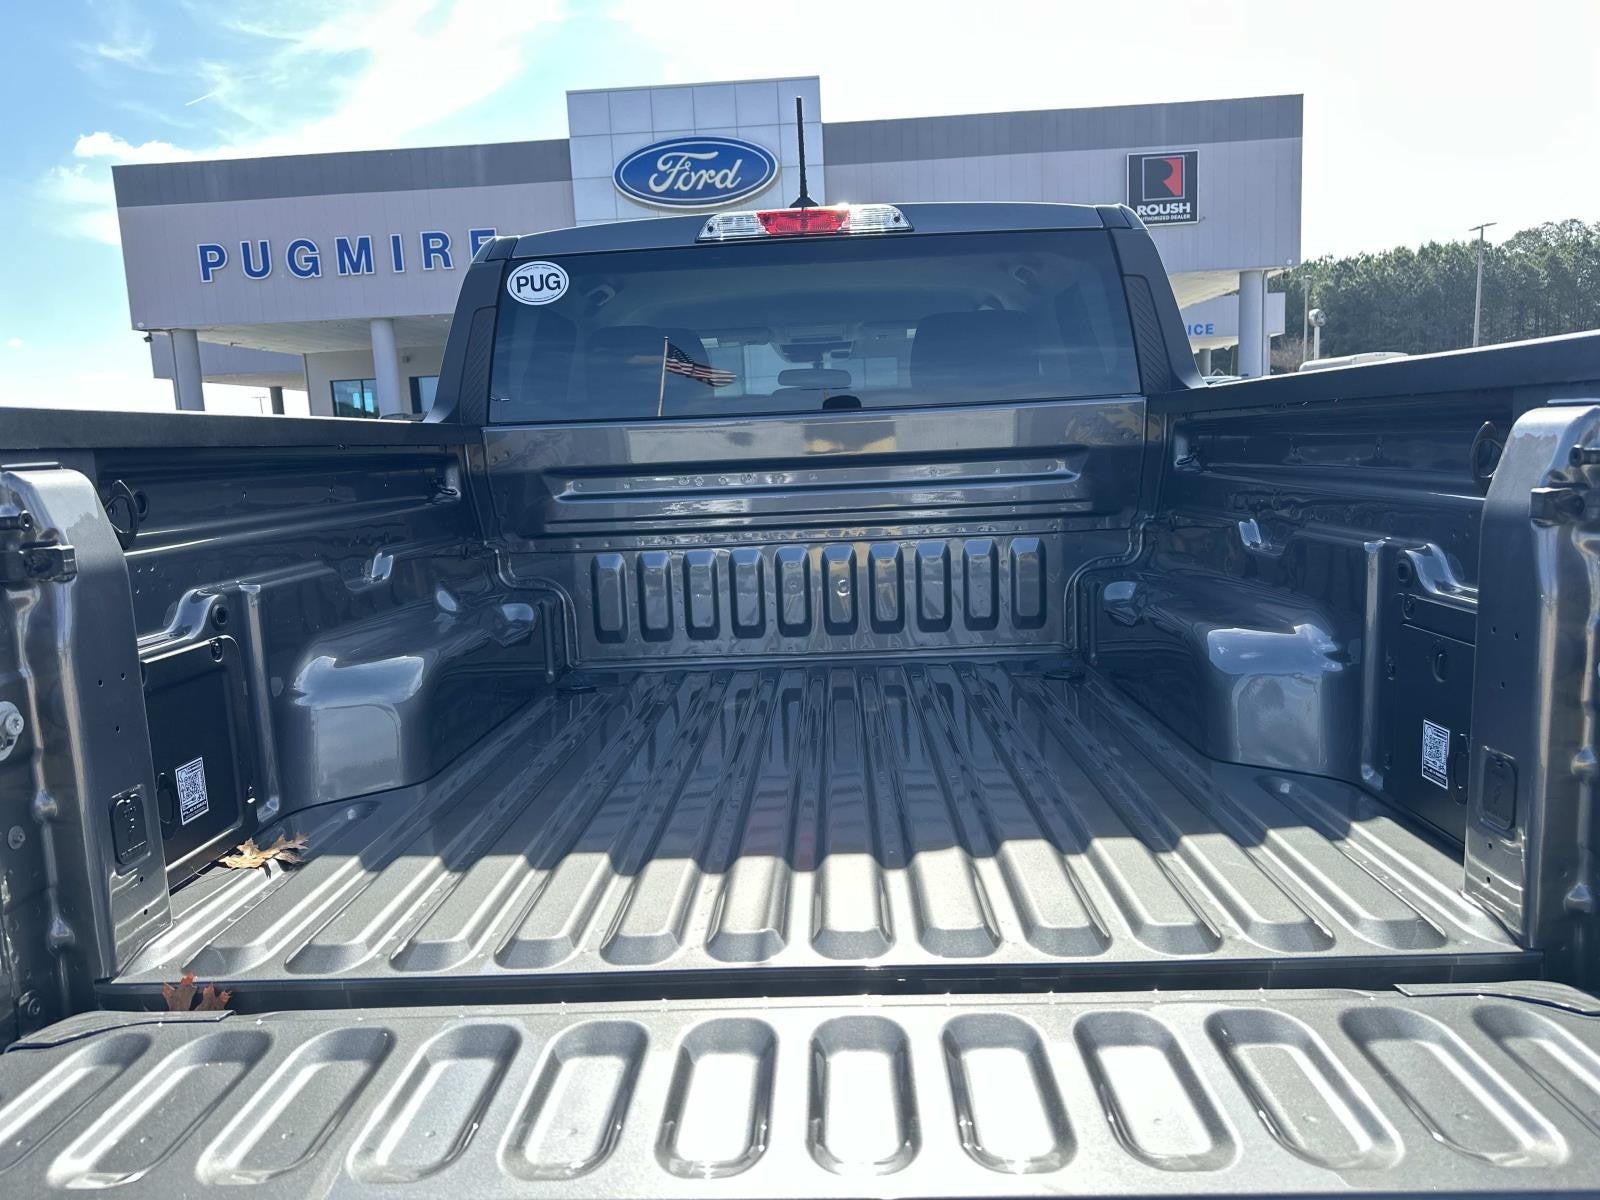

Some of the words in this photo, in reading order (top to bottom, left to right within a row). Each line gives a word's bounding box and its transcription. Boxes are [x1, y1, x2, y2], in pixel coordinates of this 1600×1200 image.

[649, 151, 743, 193] Ford
[1136, 202, 1191, 216] ROUSH
[516, 272, 561, 293] PUG
